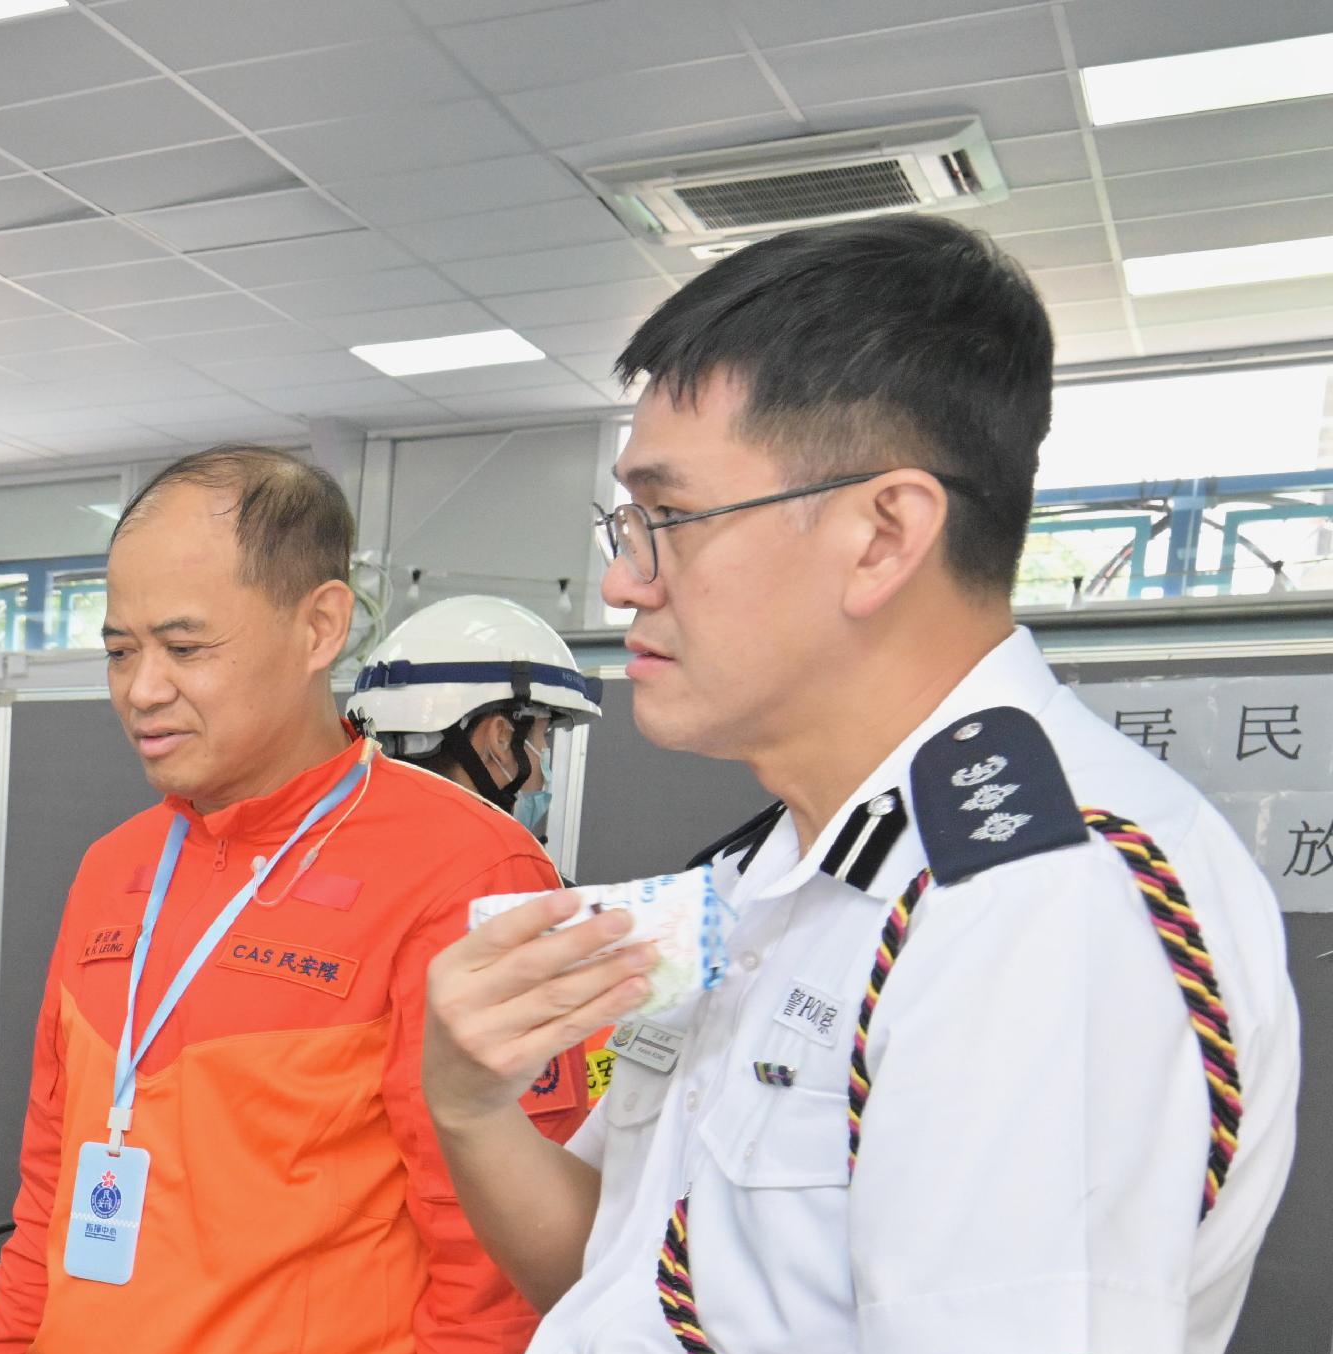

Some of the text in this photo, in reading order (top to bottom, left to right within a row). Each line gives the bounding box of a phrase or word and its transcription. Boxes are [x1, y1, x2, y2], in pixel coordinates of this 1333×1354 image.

[233, 944, 340, 983] CAS 民安隊
